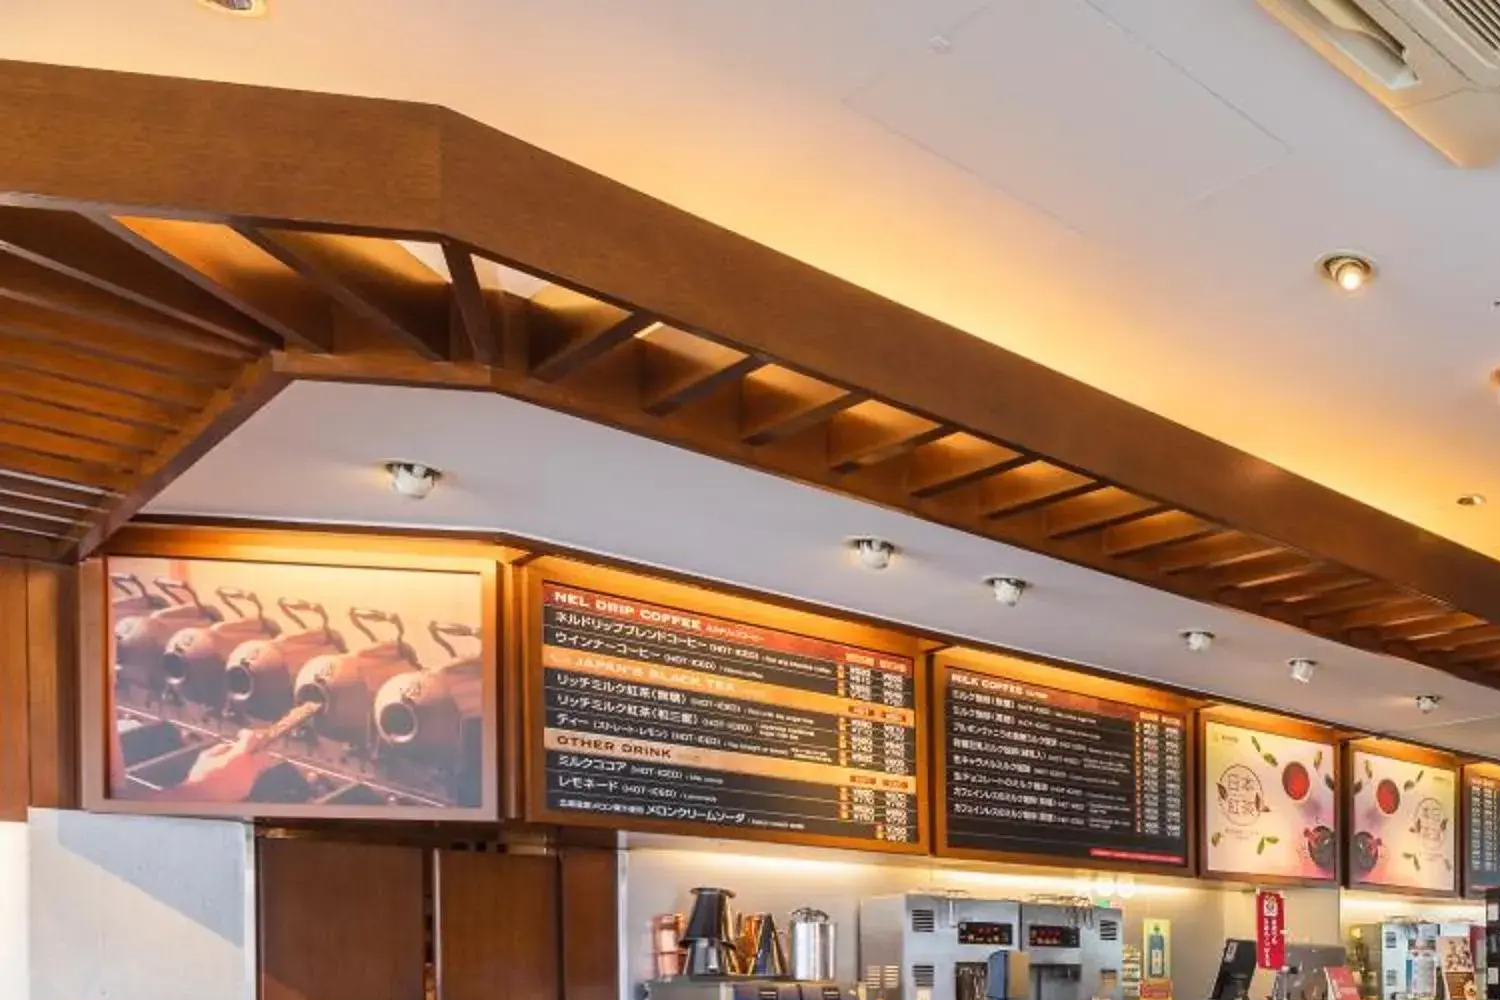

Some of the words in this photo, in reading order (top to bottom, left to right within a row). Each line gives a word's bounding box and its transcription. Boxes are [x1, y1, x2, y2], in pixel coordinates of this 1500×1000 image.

[555, 592, 589, 607] NEL
[595, 599, 635, 615] DRIP
[639, 609, 701, 629] COFFEE
[556, 735, 615, 750] OTHER
[620, 742, 672, 759] DRINK
